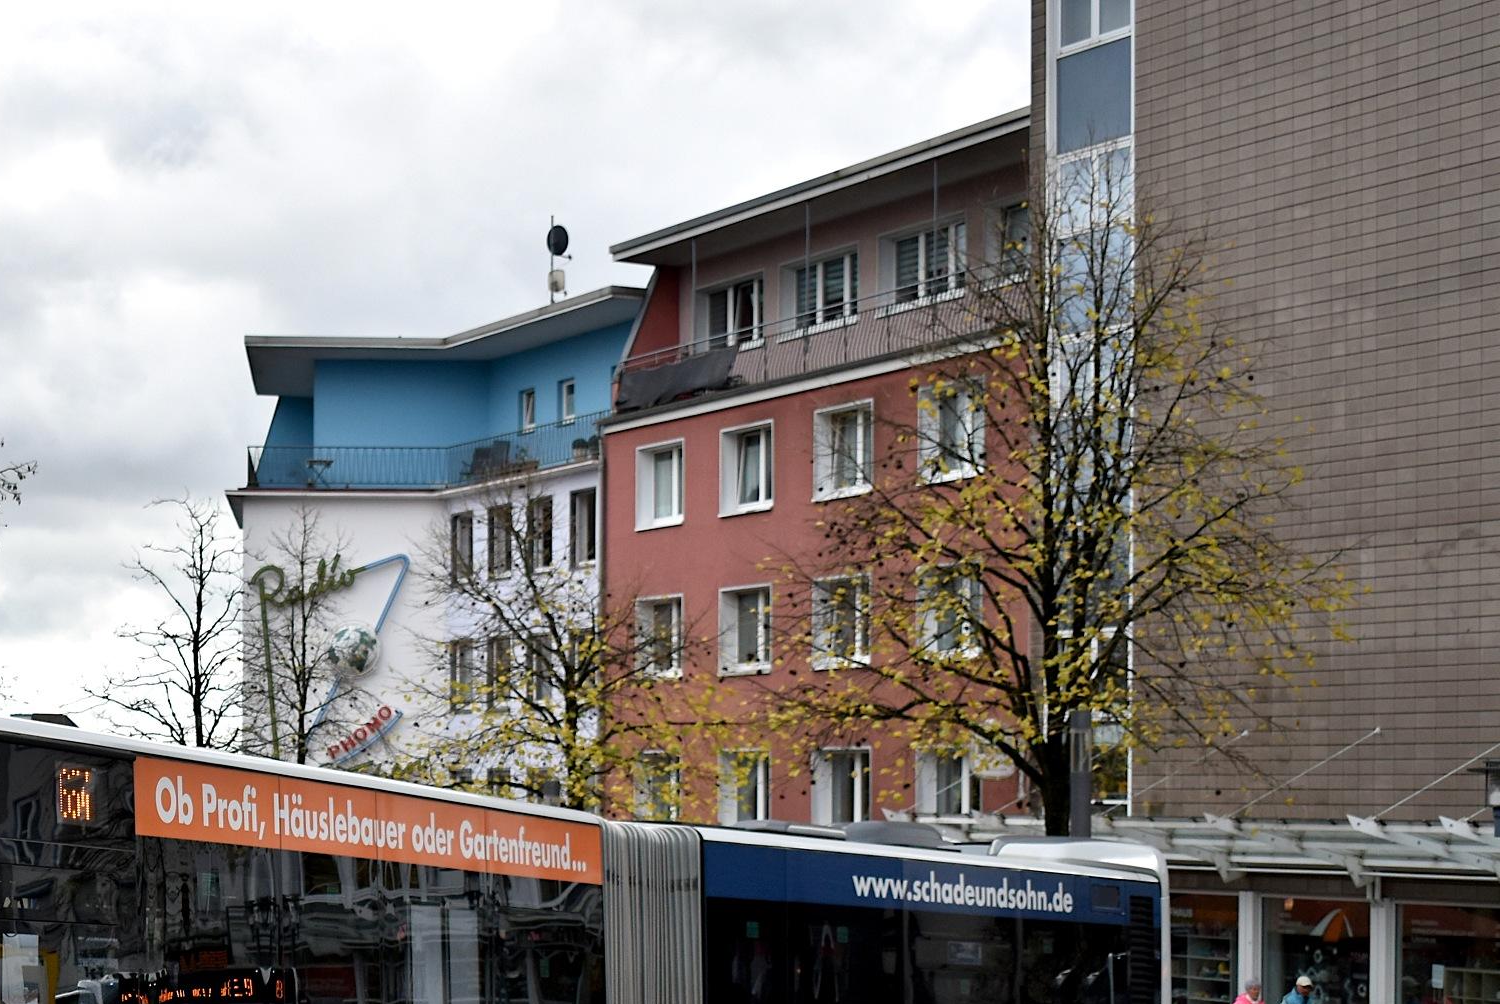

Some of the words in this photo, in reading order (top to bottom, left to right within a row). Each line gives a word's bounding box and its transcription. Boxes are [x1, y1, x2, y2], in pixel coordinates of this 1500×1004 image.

[155, 775, 194, 826] Ob
[202, 783, 266, 841] Profi,
[273, 793, 406, 850] Häuslebauer
[411, 812, 455, 856] oder
[459, 819, 587, 872] Gartenfreund...
[852, 870, 1074, 914] www.schadeundsohn.de
